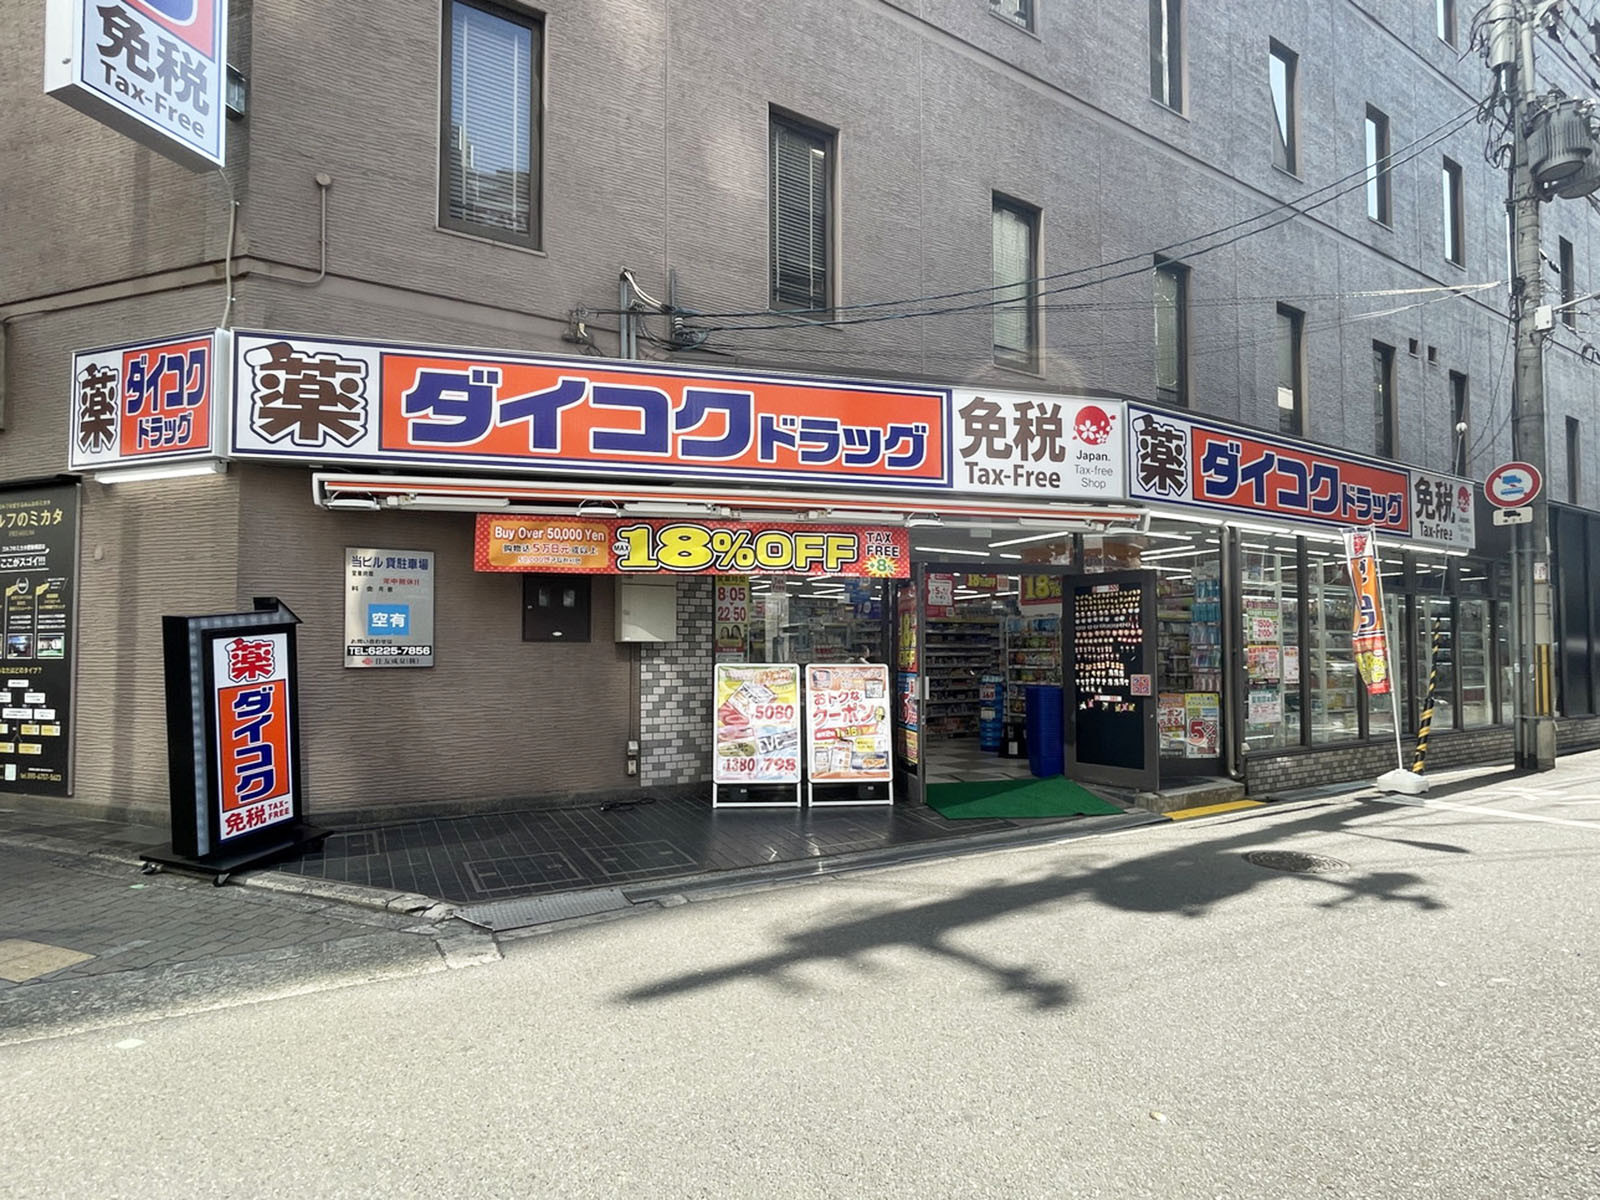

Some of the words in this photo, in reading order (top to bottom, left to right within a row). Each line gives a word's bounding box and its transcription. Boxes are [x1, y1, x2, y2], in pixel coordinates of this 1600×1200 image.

[97, 5, 209, 115] 免税
[100, 61, 205, 138] Tax-Free
[126, 349, 206, 414] ダイコク
[245, 342, 364, 444] 薬
[79, 364, 117, 452] 薬
[138, 412, 192, 447] ドラッグ
[959, 397, 1066, 463] 免税
[1076, 450, 1111, 462] Japan.
[1134, 415, 1186, 493] 薬
[964, 462, 1061, 488] Tax-Free
[1075, 464, 1113, 476] Tax-free
[1081, 478, 1106, 489] Shop
[1415, 477, 1455, 523] 免税
[495, 526, 515, 540] Buy
[518, 527, 544, 539] Over
[547, 528, 582, 541] 50,000
[585, 529, 604, 541] Yen
[866, 531, 892, 544] TAX
[1419, 521, 1452, 540] Tax-Free
[613, 544, 630, 552] MAX
[618, 524, 858, 570] 18%OFF
[866, 545, 899, 557] FREE
[352, 555, 383, 568] 当ビル
[718, 587, 746, 601] 8:05
[371, 612, 406, 628] 空有
[227, 638, 274, 682] 薬
[813, 703, 874, 728] クーポン
[233, 686, 275, 803] ダイコク
[268, 801, 288, 811] TAX-
[268, 809, 290, 820] FREE
[225, 806, 267, 836] 免税
